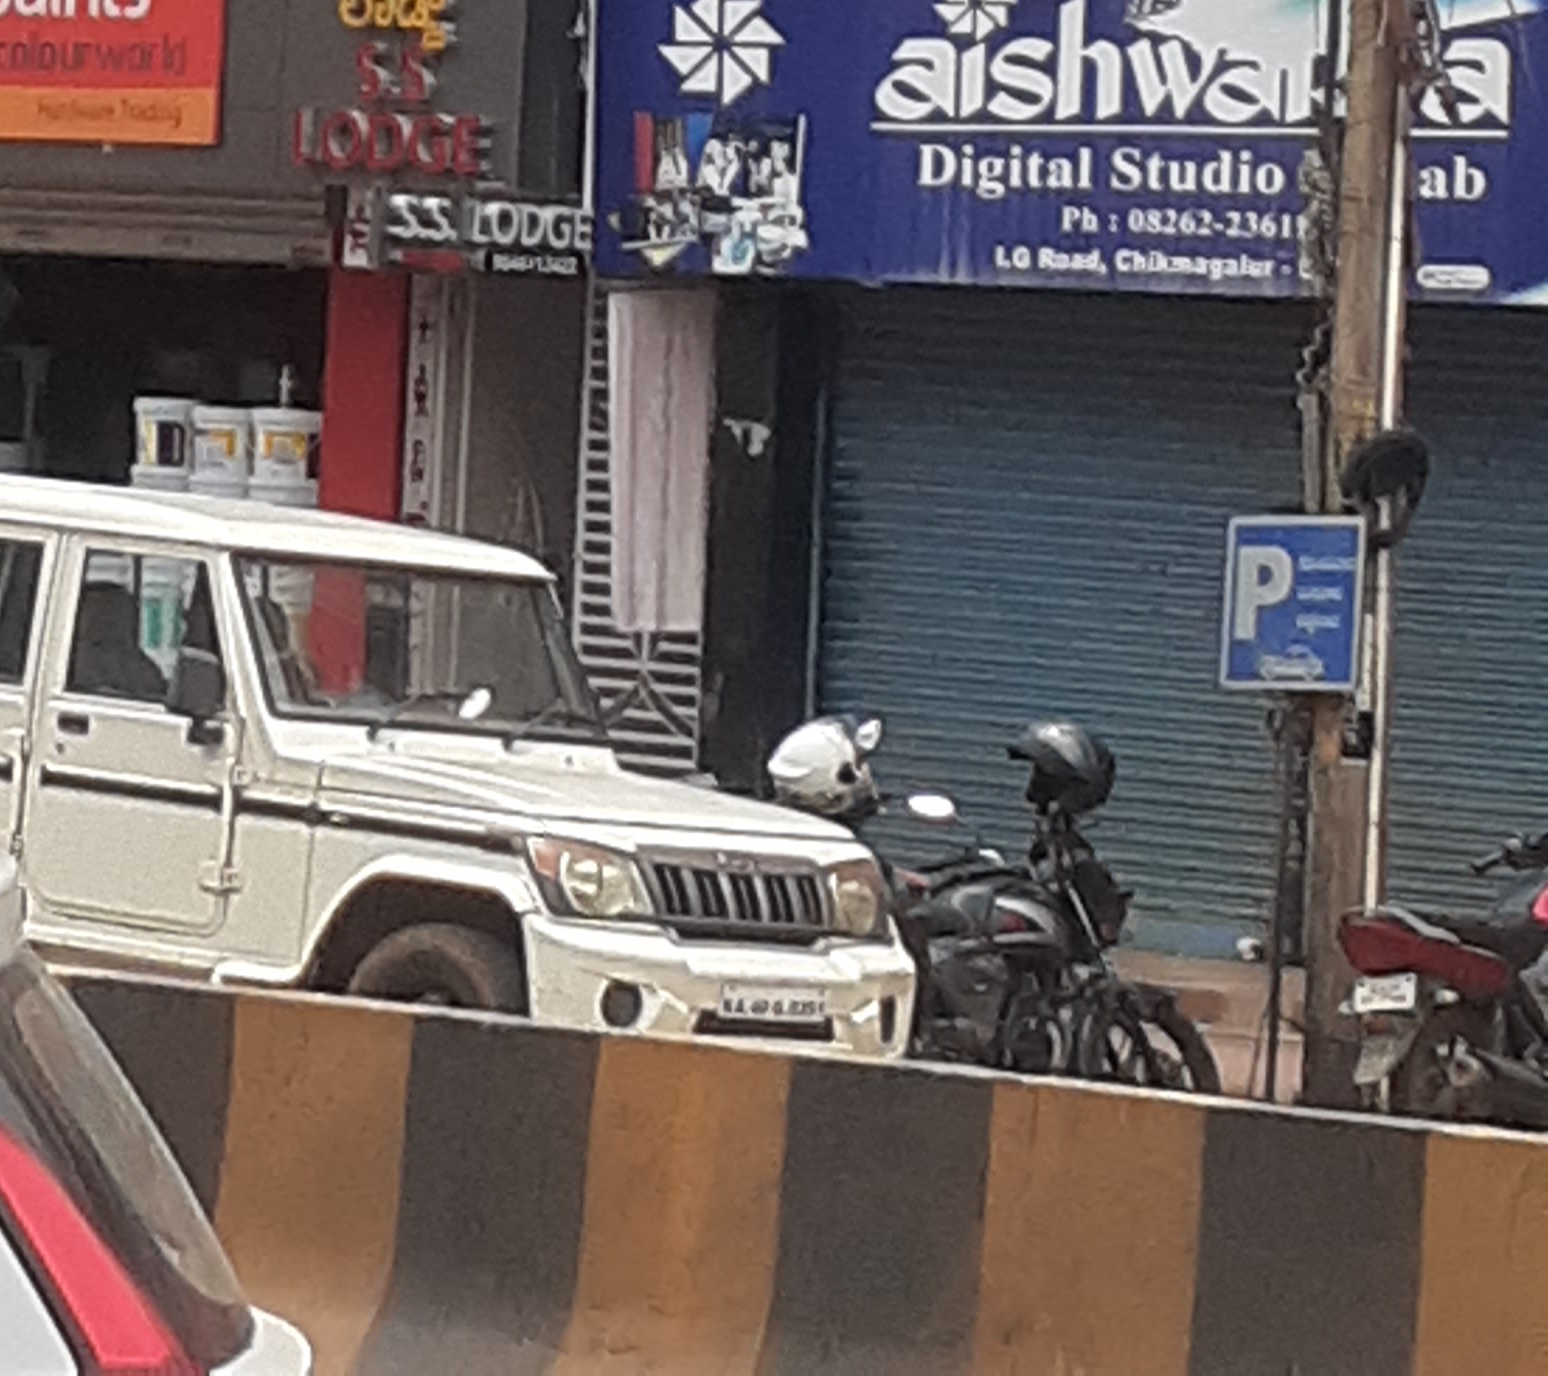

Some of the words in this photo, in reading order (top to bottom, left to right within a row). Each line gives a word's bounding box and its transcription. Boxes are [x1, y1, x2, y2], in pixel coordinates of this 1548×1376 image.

[293, 110, 493, 180] LODGE
[918, 143, 1092, 193] Digital
[1109, 146, 1286, 198] Studio
[1418, 155, 1488, 201] ab
[470, 200, 594, 251] LODGE
[1061, 205, 1099, 234] Ph
[1233, 545, 1294, 640] P
